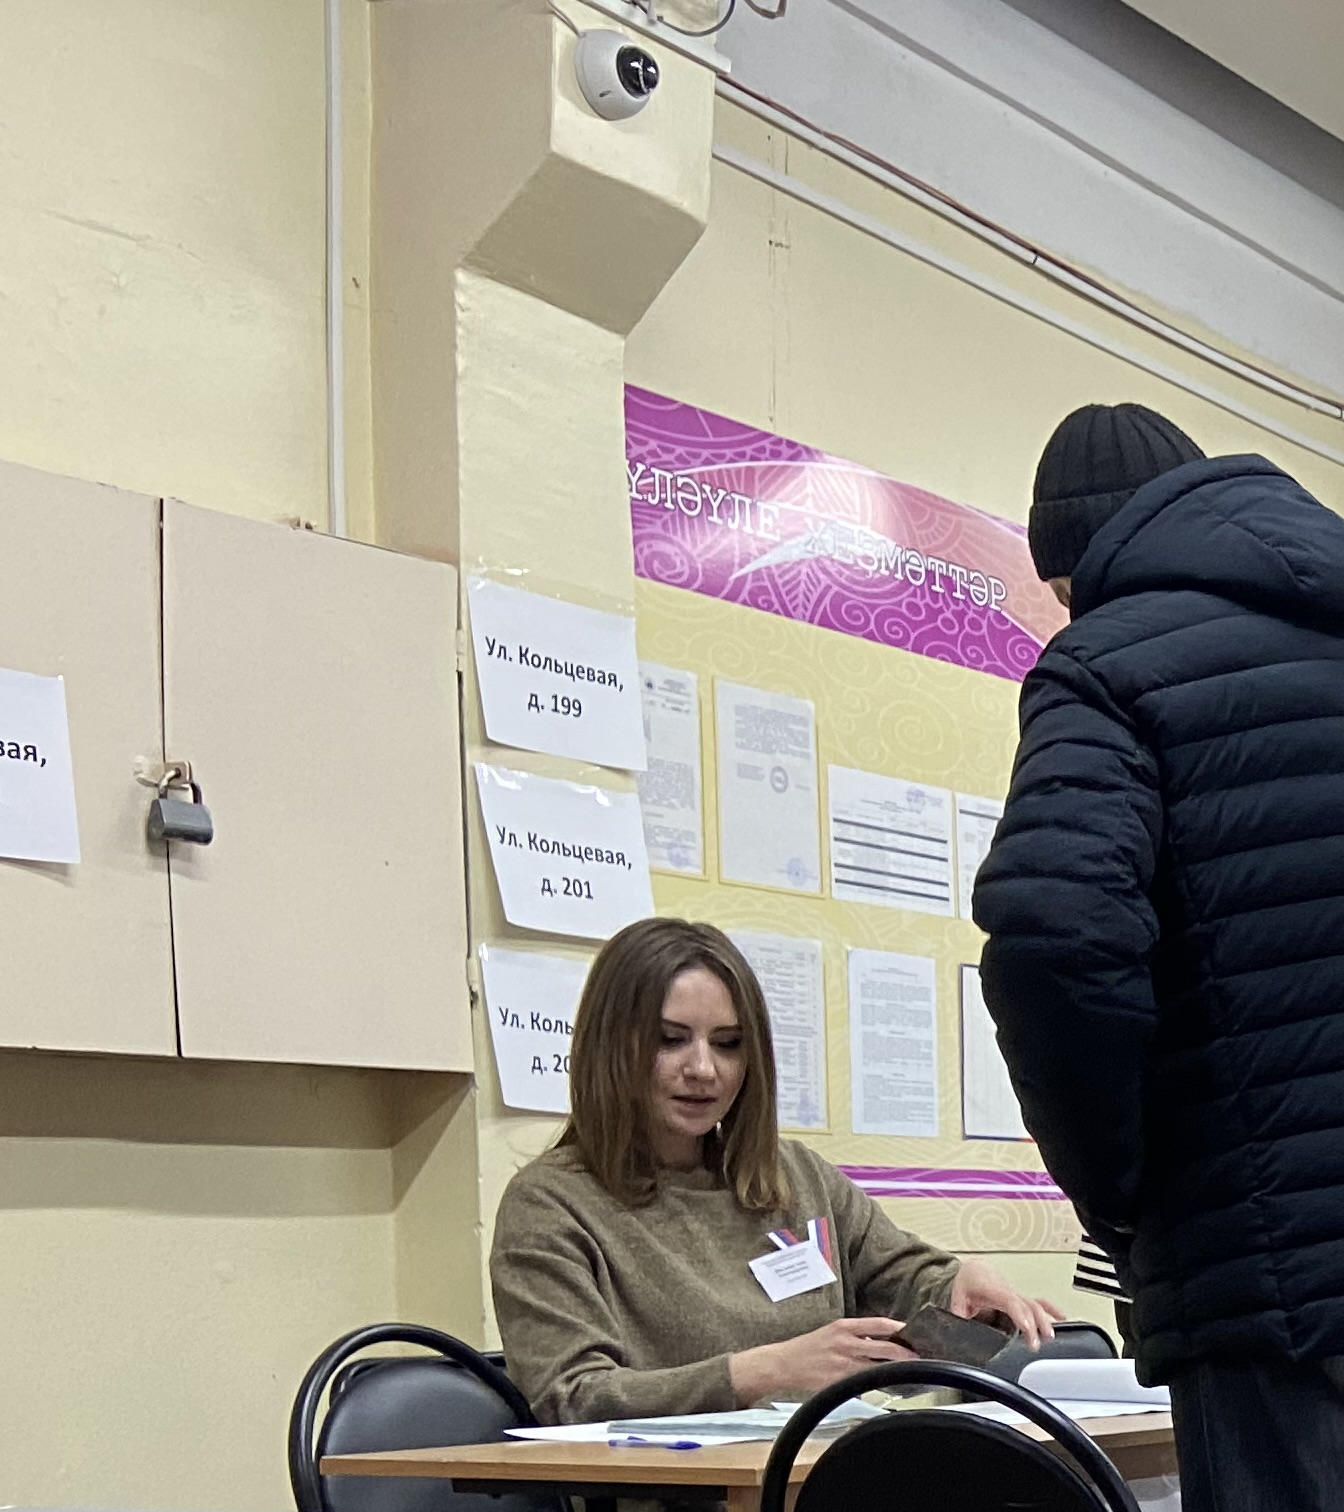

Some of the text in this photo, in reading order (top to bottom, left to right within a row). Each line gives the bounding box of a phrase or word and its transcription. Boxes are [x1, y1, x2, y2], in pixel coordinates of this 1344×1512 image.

[485, 635, 624, 692] Ул. Кольцевая,
[527, 692, 583, 718] д. 199
[495, 824, 523, 849] Ул.
[527, 831, 633, 870] Кольцевая,
[541, 876, 594, 900] д. 201
[498, 1006, 525, 1029] Ул.
[531, 1055, 548, 1075] д.
